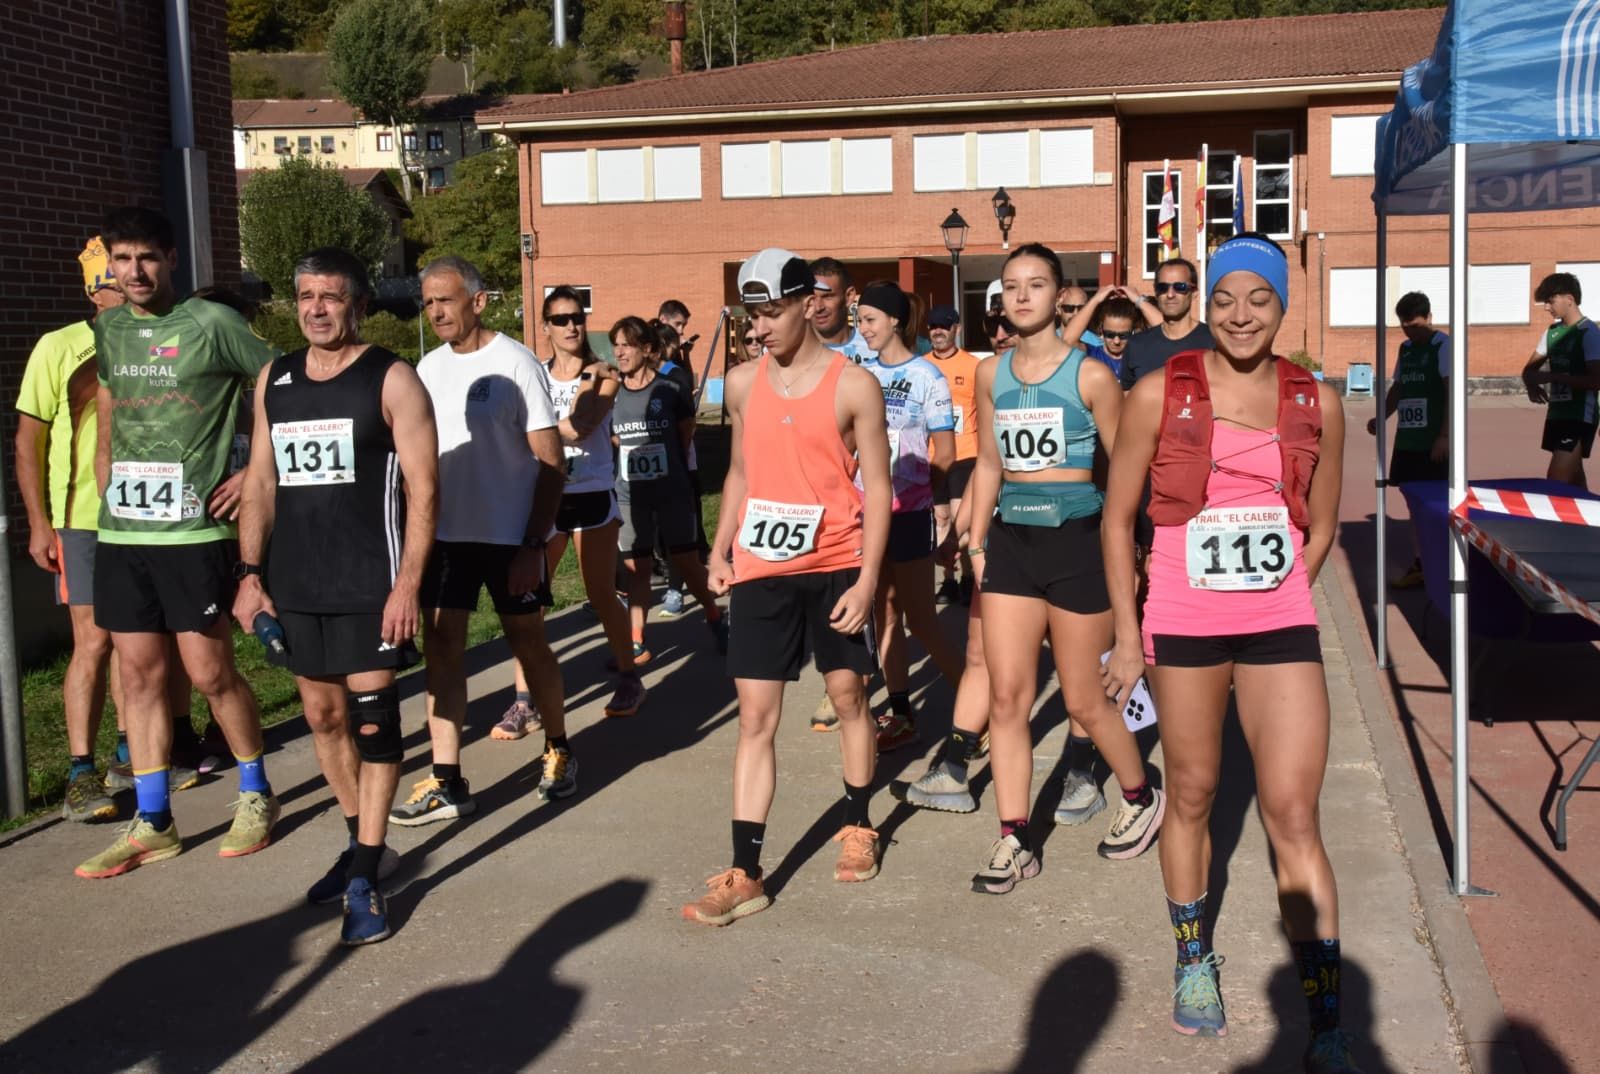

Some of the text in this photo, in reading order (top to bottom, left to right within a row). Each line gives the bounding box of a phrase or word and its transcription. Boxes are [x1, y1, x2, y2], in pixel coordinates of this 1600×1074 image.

[113, 365, 177, 377] LABORAL
[149, 379, 177, 387] kutxa
[1399, 407, 1424, 423] 108
[278, 426, 299, 434] TRAIL
[613, 420, 669, 434] BARRUELO
[1000, 428, 1058, 459] 106
[284, 440, 346, 473] 131
[627, 455, 664, 475] 101
[116, 480, 175, 509] 114
[752, 503, 774, 513] TRAIL
[1195, 513, 1220, 525] TRAIL
[749, 520, 810, 551] 105
[1201, 532, 1286, 574] 113
